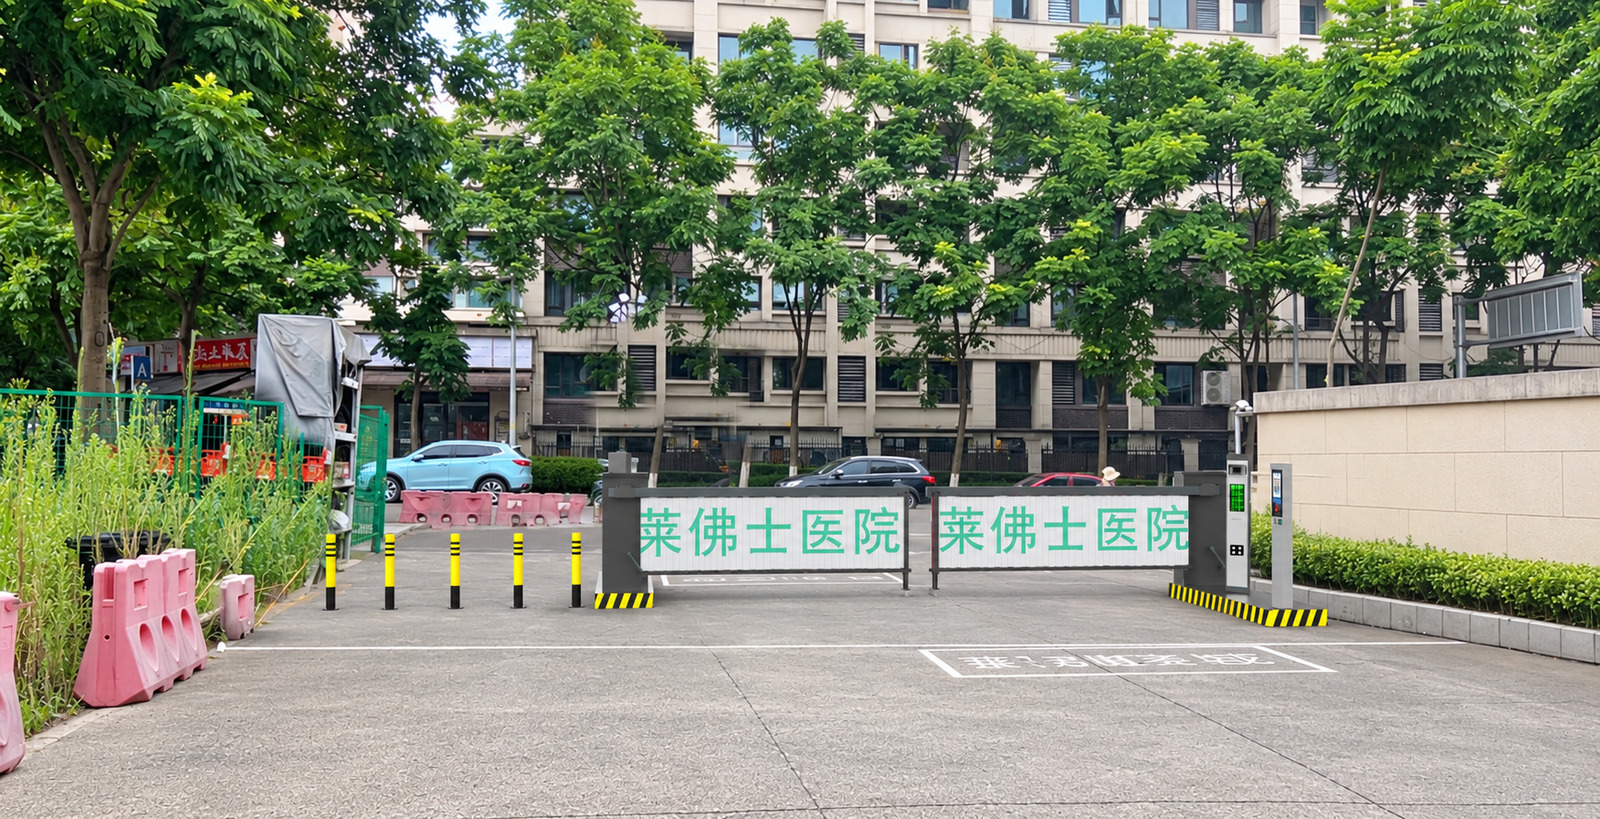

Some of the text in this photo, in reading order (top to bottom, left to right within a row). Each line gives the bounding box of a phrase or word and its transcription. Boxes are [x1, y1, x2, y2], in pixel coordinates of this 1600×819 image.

[137, 362, 147, 378] A
[640, 507, 900, 557] 莱佛士医院
[939, 505, 1189, 554] 莱佛士医院
